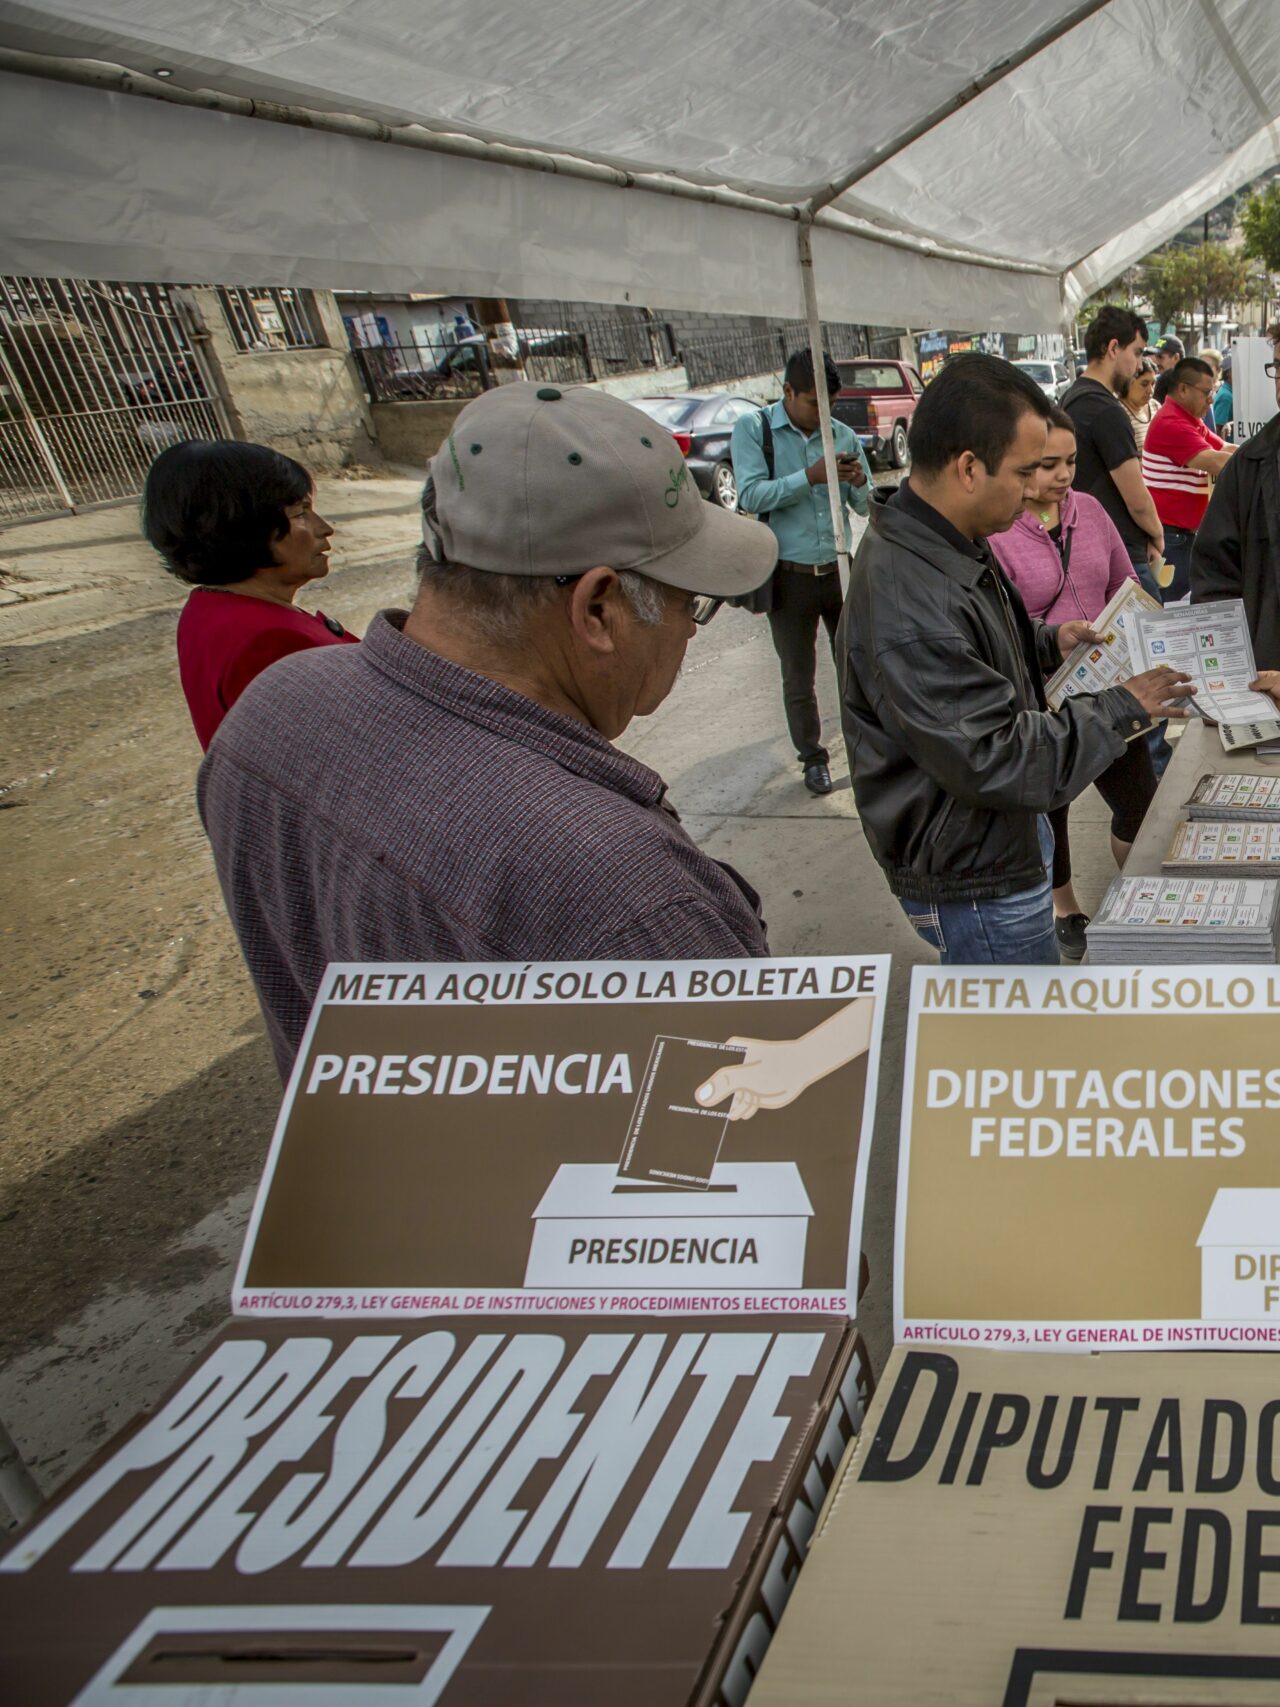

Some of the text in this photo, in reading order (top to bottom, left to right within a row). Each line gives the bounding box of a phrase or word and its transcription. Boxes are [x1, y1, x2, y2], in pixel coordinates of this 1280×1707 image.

[1238, 421, 1265, 438] EL VOT
[328, 964, 876, 1004] META AQUÍ SOLO LA BOLETA DE
[922, 978, 1031, 1008] META
[1041, 969, 1144, 1013] AQUÍ
[1150, 977, 1255, 1009] SOLO
[305, 1053, 633, 1095] PRESIDENCIA
[970, 1116, 1246, 1158] FEDERALES
[568, 1238, 759, 1264] PRESIDENCIA
[240, 1292, 847, 1310] ARTÍCULO 279,3, LEY GENERAL DE INSTITUCIONES Y PROCEDIMIENTOS ELECTORALES
[902, 1323, 980, 1340] ARTÍCULO
[984, 1328, 1030, 1343] 279,3,
[1034, 1328, 1062, 1342] LEY
[1065, 1328, 1139, 1342] GENERAL
[1142, 1328, 1164, 1342] DE
[0, 1330, 827, 1575] PRESIDENTE
